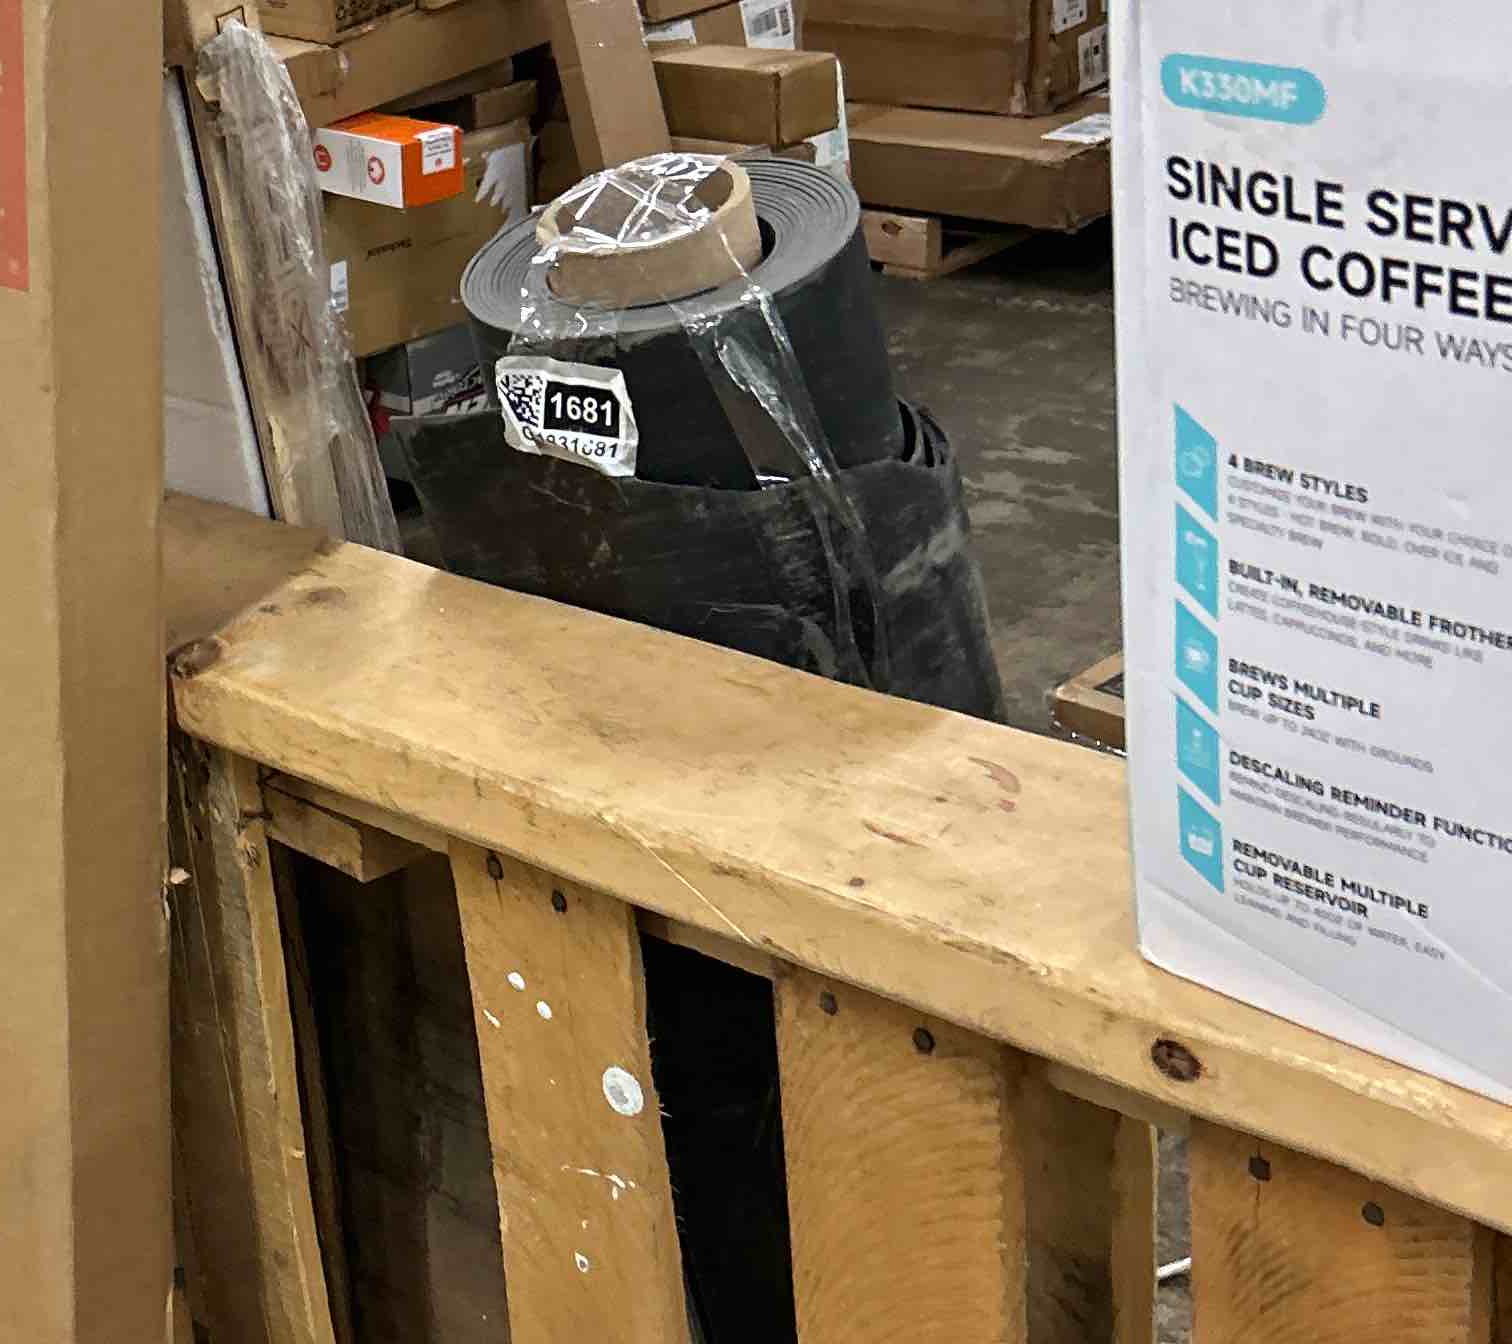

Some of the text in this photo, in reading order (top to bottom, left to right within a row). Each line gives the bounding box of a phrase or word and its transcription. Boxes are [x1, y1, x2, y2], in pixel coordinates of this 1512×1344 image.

[1179, 64, 1299, 112] K330MF
[1166, 155, 1345, 229] SINGLE
[1169, 216, 1512, 325] ICED COFFEE
[1169, 276, 1292, 329] BREWING
[1301, 304, 1330, 338] IN
[1340, 314, 1425, 356] FOUR
[550, 391, 613, 427] 1681
[1243, 457, 1294, 484] BREW
[1299, 472, 1369, 503] STYLES
[1308, 582, 1423, 627] REMOVABLE
[1228, 657, 1382, 719] BREWS MULTIPLE
[1228, 678, 1315, 721] CUP SIZES
[1229, 751, 1325, 797] DESCALING
[1330, 786, 1427, 828] REMINDER
[1232, 838, 1430, 920] REMOVABLE MULTIPLE
[1233, 858, 1268, 881] CUP
[1273, 872, 1369, 919] RESERVOIR
